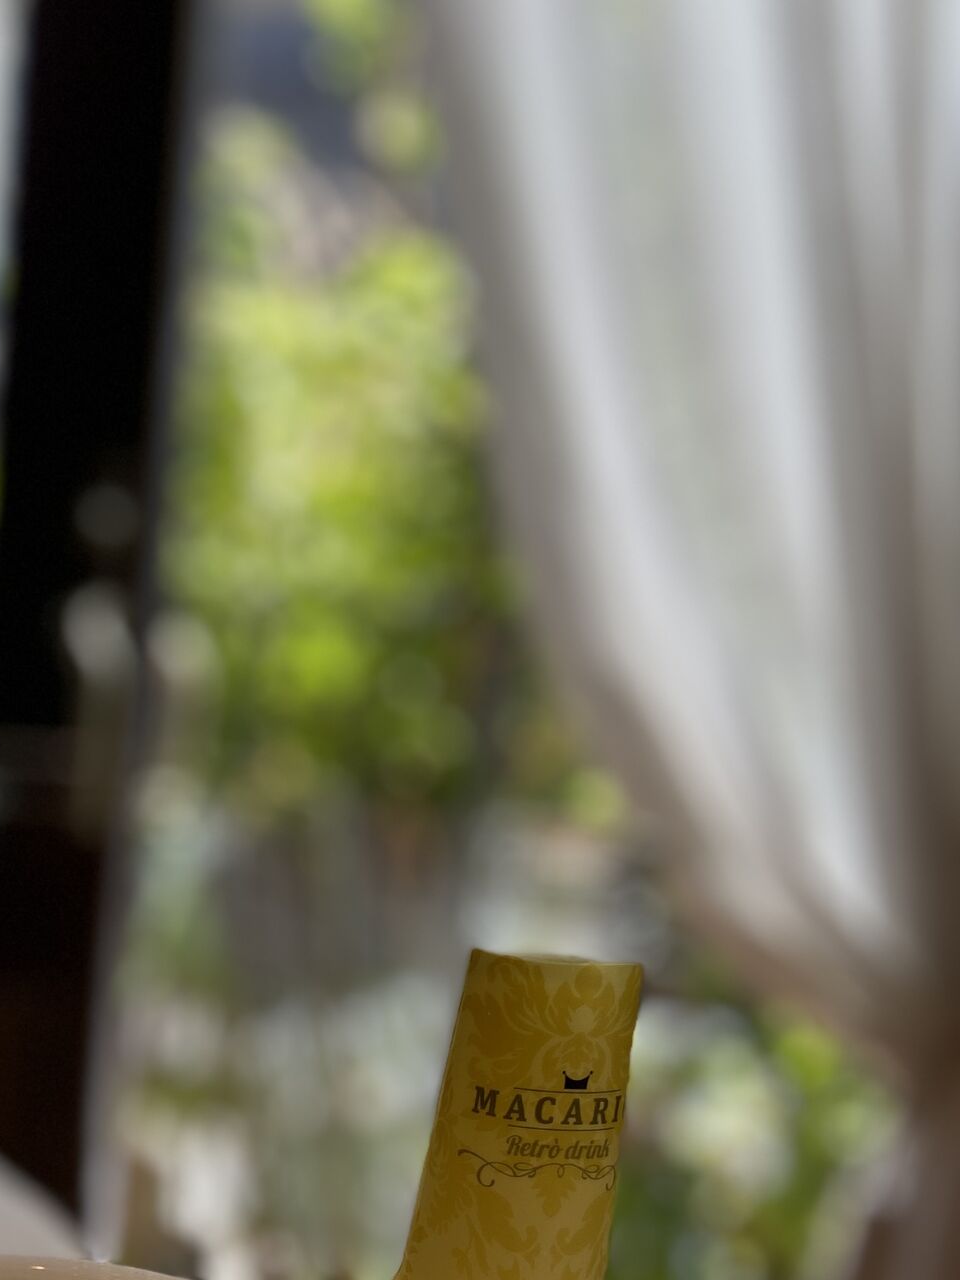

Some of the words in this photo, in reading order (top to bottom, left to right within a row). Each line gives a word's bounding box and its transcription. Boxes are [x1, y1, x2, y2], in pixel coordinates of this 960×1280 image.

[471, 1085, 626, 1126] MACARI
[506, 1134, 560, 1160] Retrò
[565, 1138, 609, 1161] drink
